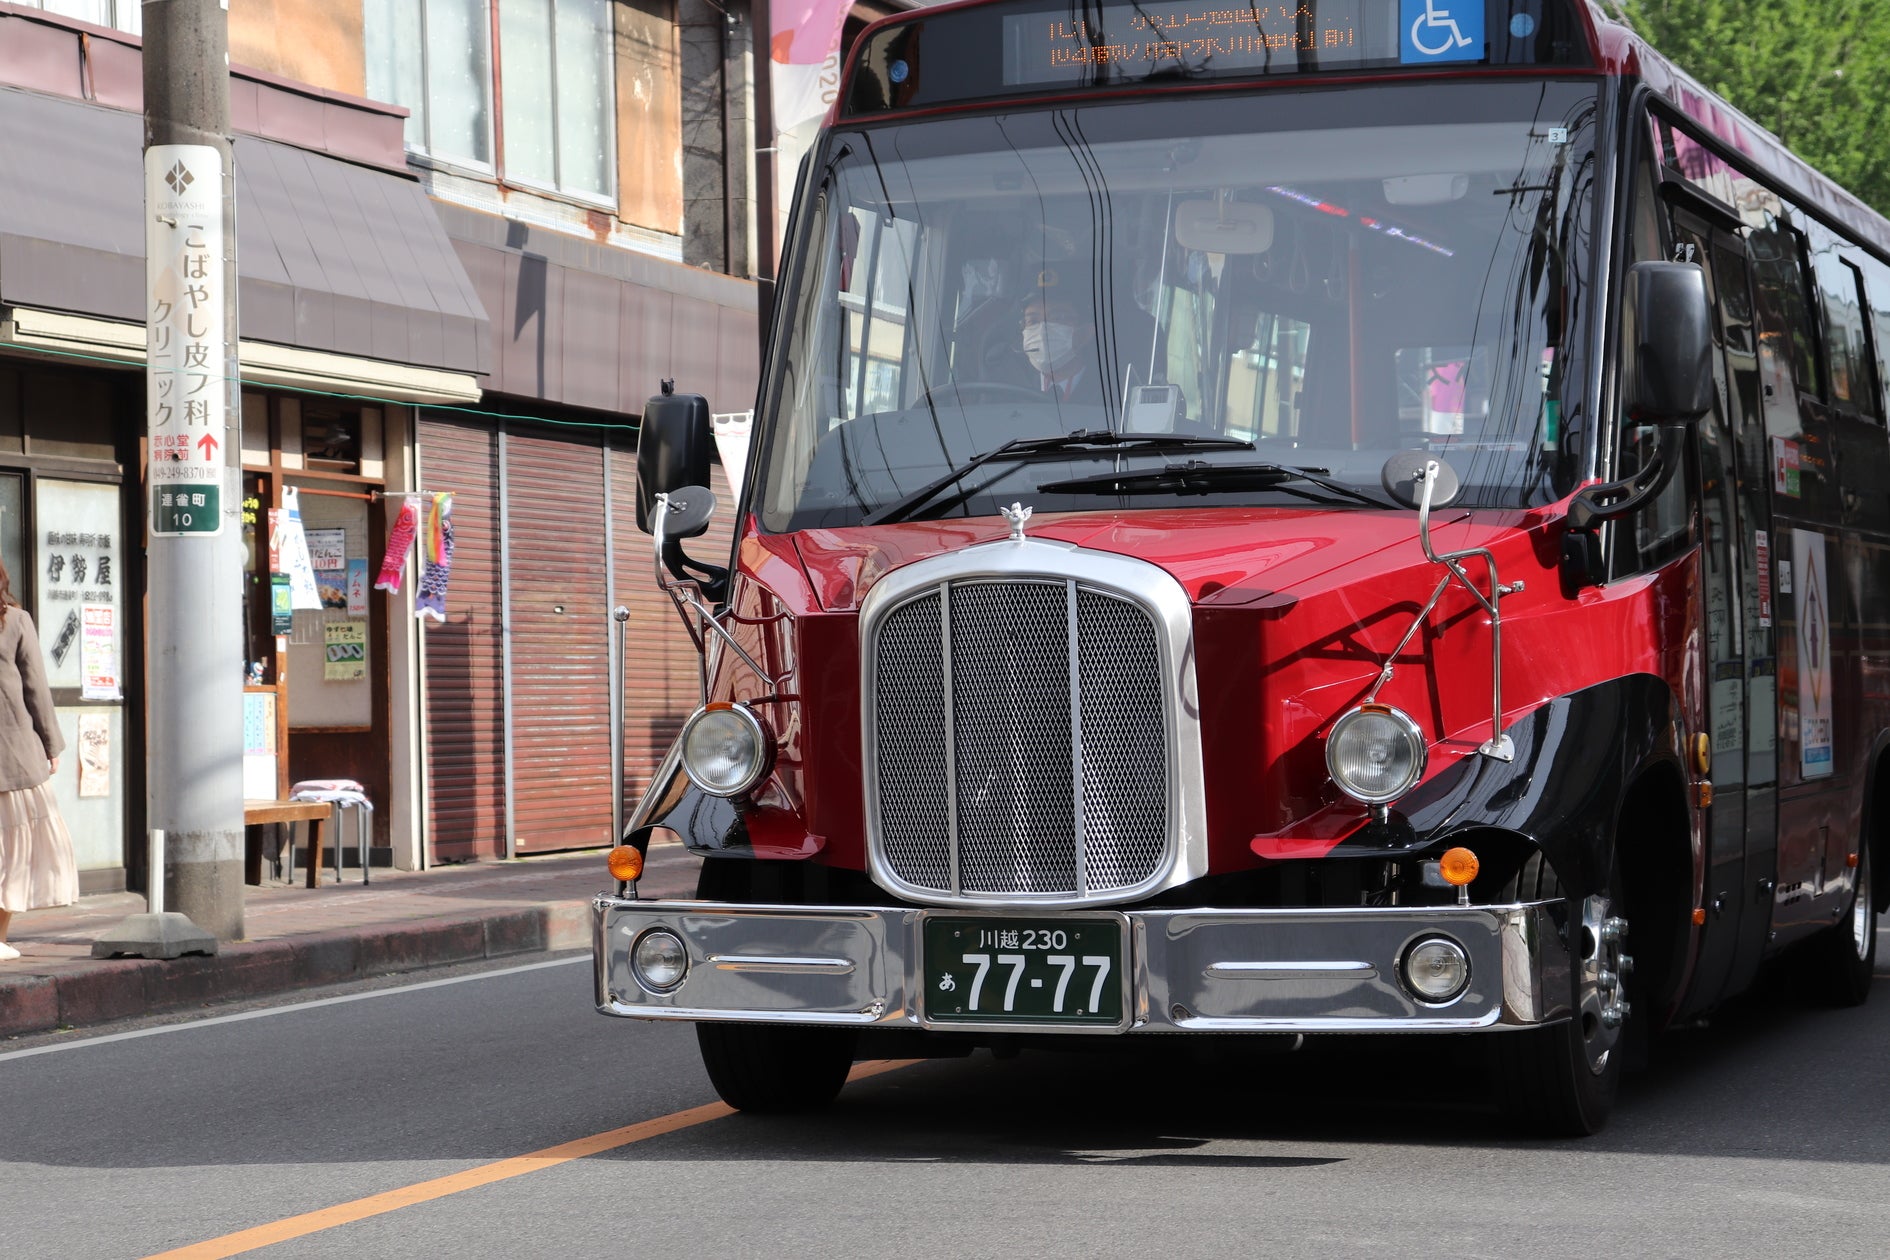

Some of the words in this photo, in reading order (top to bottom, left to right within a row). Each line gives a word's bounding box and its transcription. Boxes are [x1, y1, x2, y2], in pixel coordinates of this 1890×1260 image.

[183, 224, 211, 427] こばやし皮フ科
[153, 299, 174, 427] クリニック
[161, 493, 206, 508] 連雀町
[173, 513, 192, 526] 10
[47, 552, 112, 585] 伊勢屋
[979, 929, 1067, 950] 川越230
[938, 972, 956, 992] あ
[962, 954, 1111, 1013] 77-77
